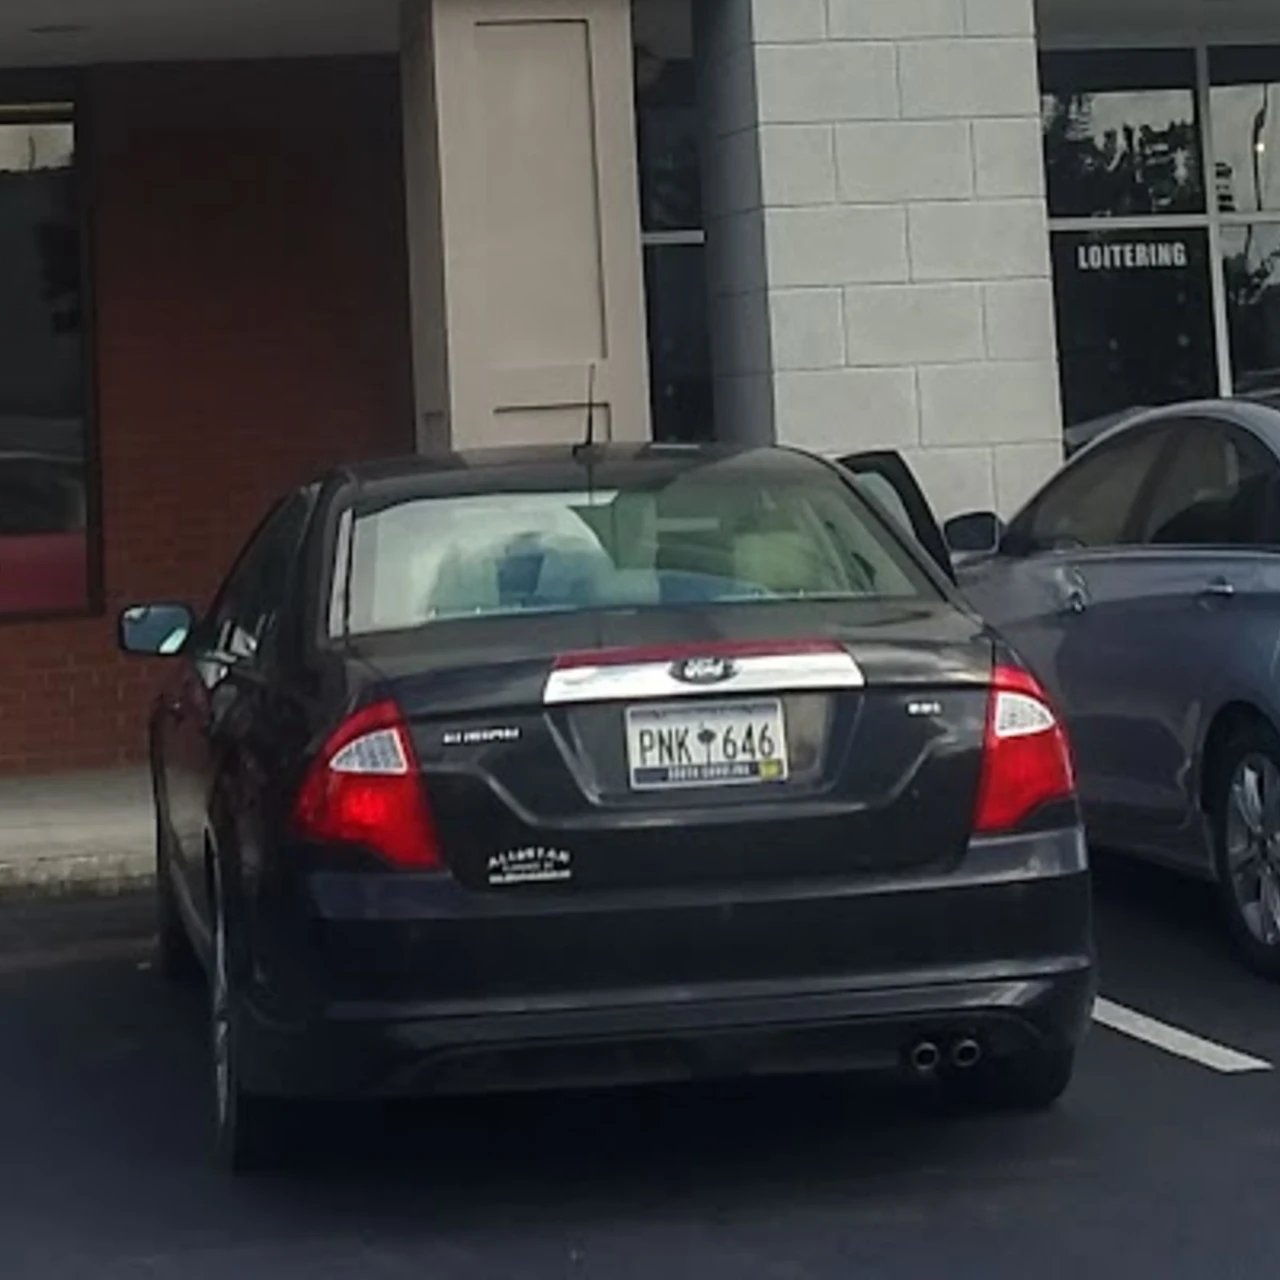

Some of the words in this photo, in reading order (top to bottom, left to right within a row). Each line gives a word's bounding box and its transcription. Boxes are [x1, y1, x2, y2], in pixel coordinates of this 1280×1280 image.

[1077, 242, 1187, 269] LOITERING
[639, 728, 691, 764] PNK
[723, 722, 773, 759] 646
